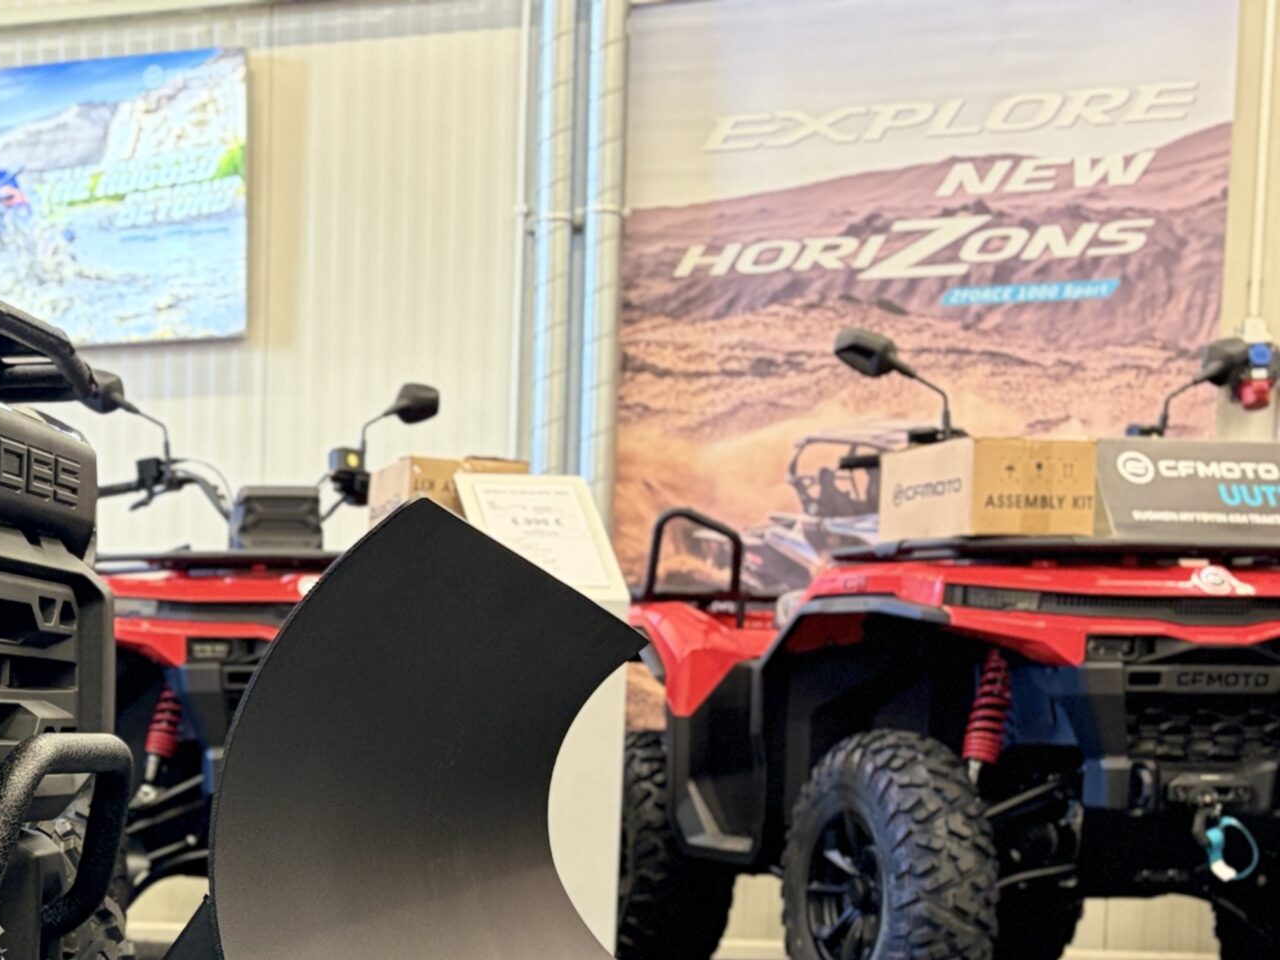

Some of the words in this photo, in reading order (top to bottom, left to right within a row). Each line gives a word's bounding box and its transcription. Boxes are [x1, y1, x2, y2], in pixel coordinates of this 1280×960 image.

[702, 82, 1198, 153] EXPLORE
[934, 151, 1157, 198] NEW
[673, 214, 1156, 280] HORIZONS
[1157, 459, 1280, 480] CFMOTO
[984, 494, 1065, 510] ASSEMBLY
[1071, 495, 1094, 510] KIT
[1218, 484, 1280, 507] UUT
[1177, 671, 1269, 688] CFMOTO
